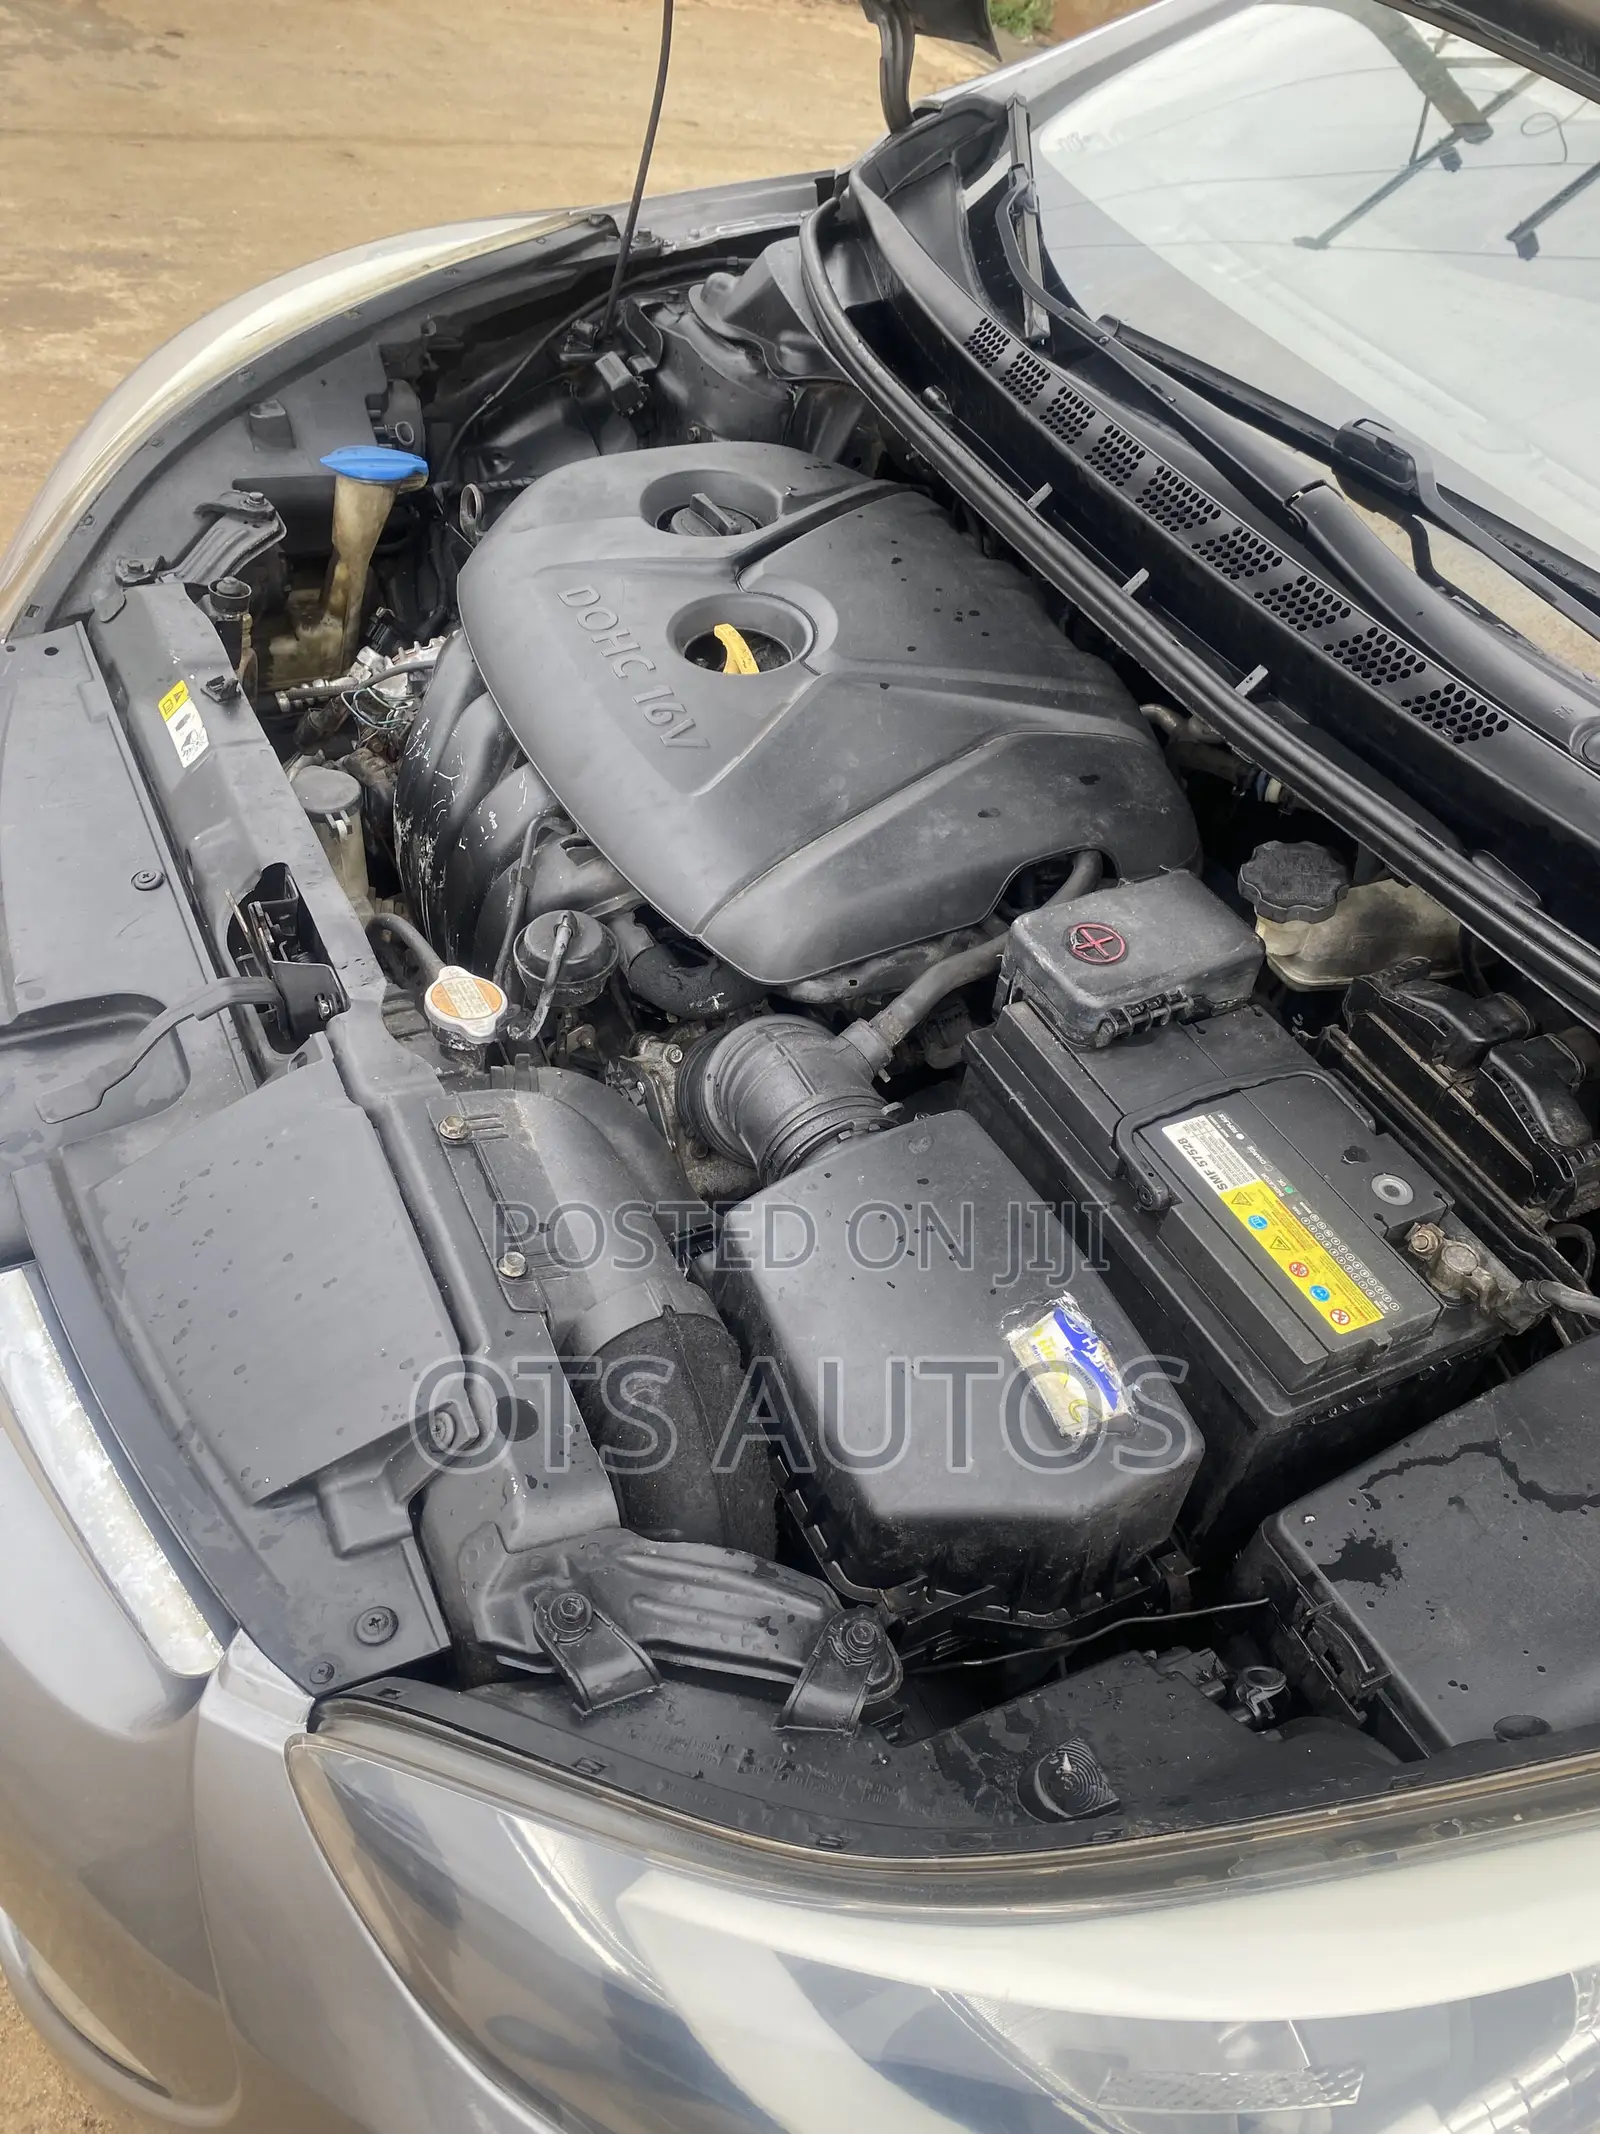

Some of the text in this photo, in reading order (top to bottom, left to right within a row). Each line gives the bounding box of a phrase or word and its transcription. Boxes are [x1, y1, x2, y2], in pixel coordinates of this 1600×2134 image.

[557, 584, 710, 749] DOHC 16V
[1217, 1113, 1239, 1134] REPLACE
[1178, 1137, 1208, 1167] 57528
[1246, 1145, 1267, 1165] CHARGE
[1203, 1169, 1229, 1191] SMF
[1260, 1173, 1285, 1197] INDICATOR
